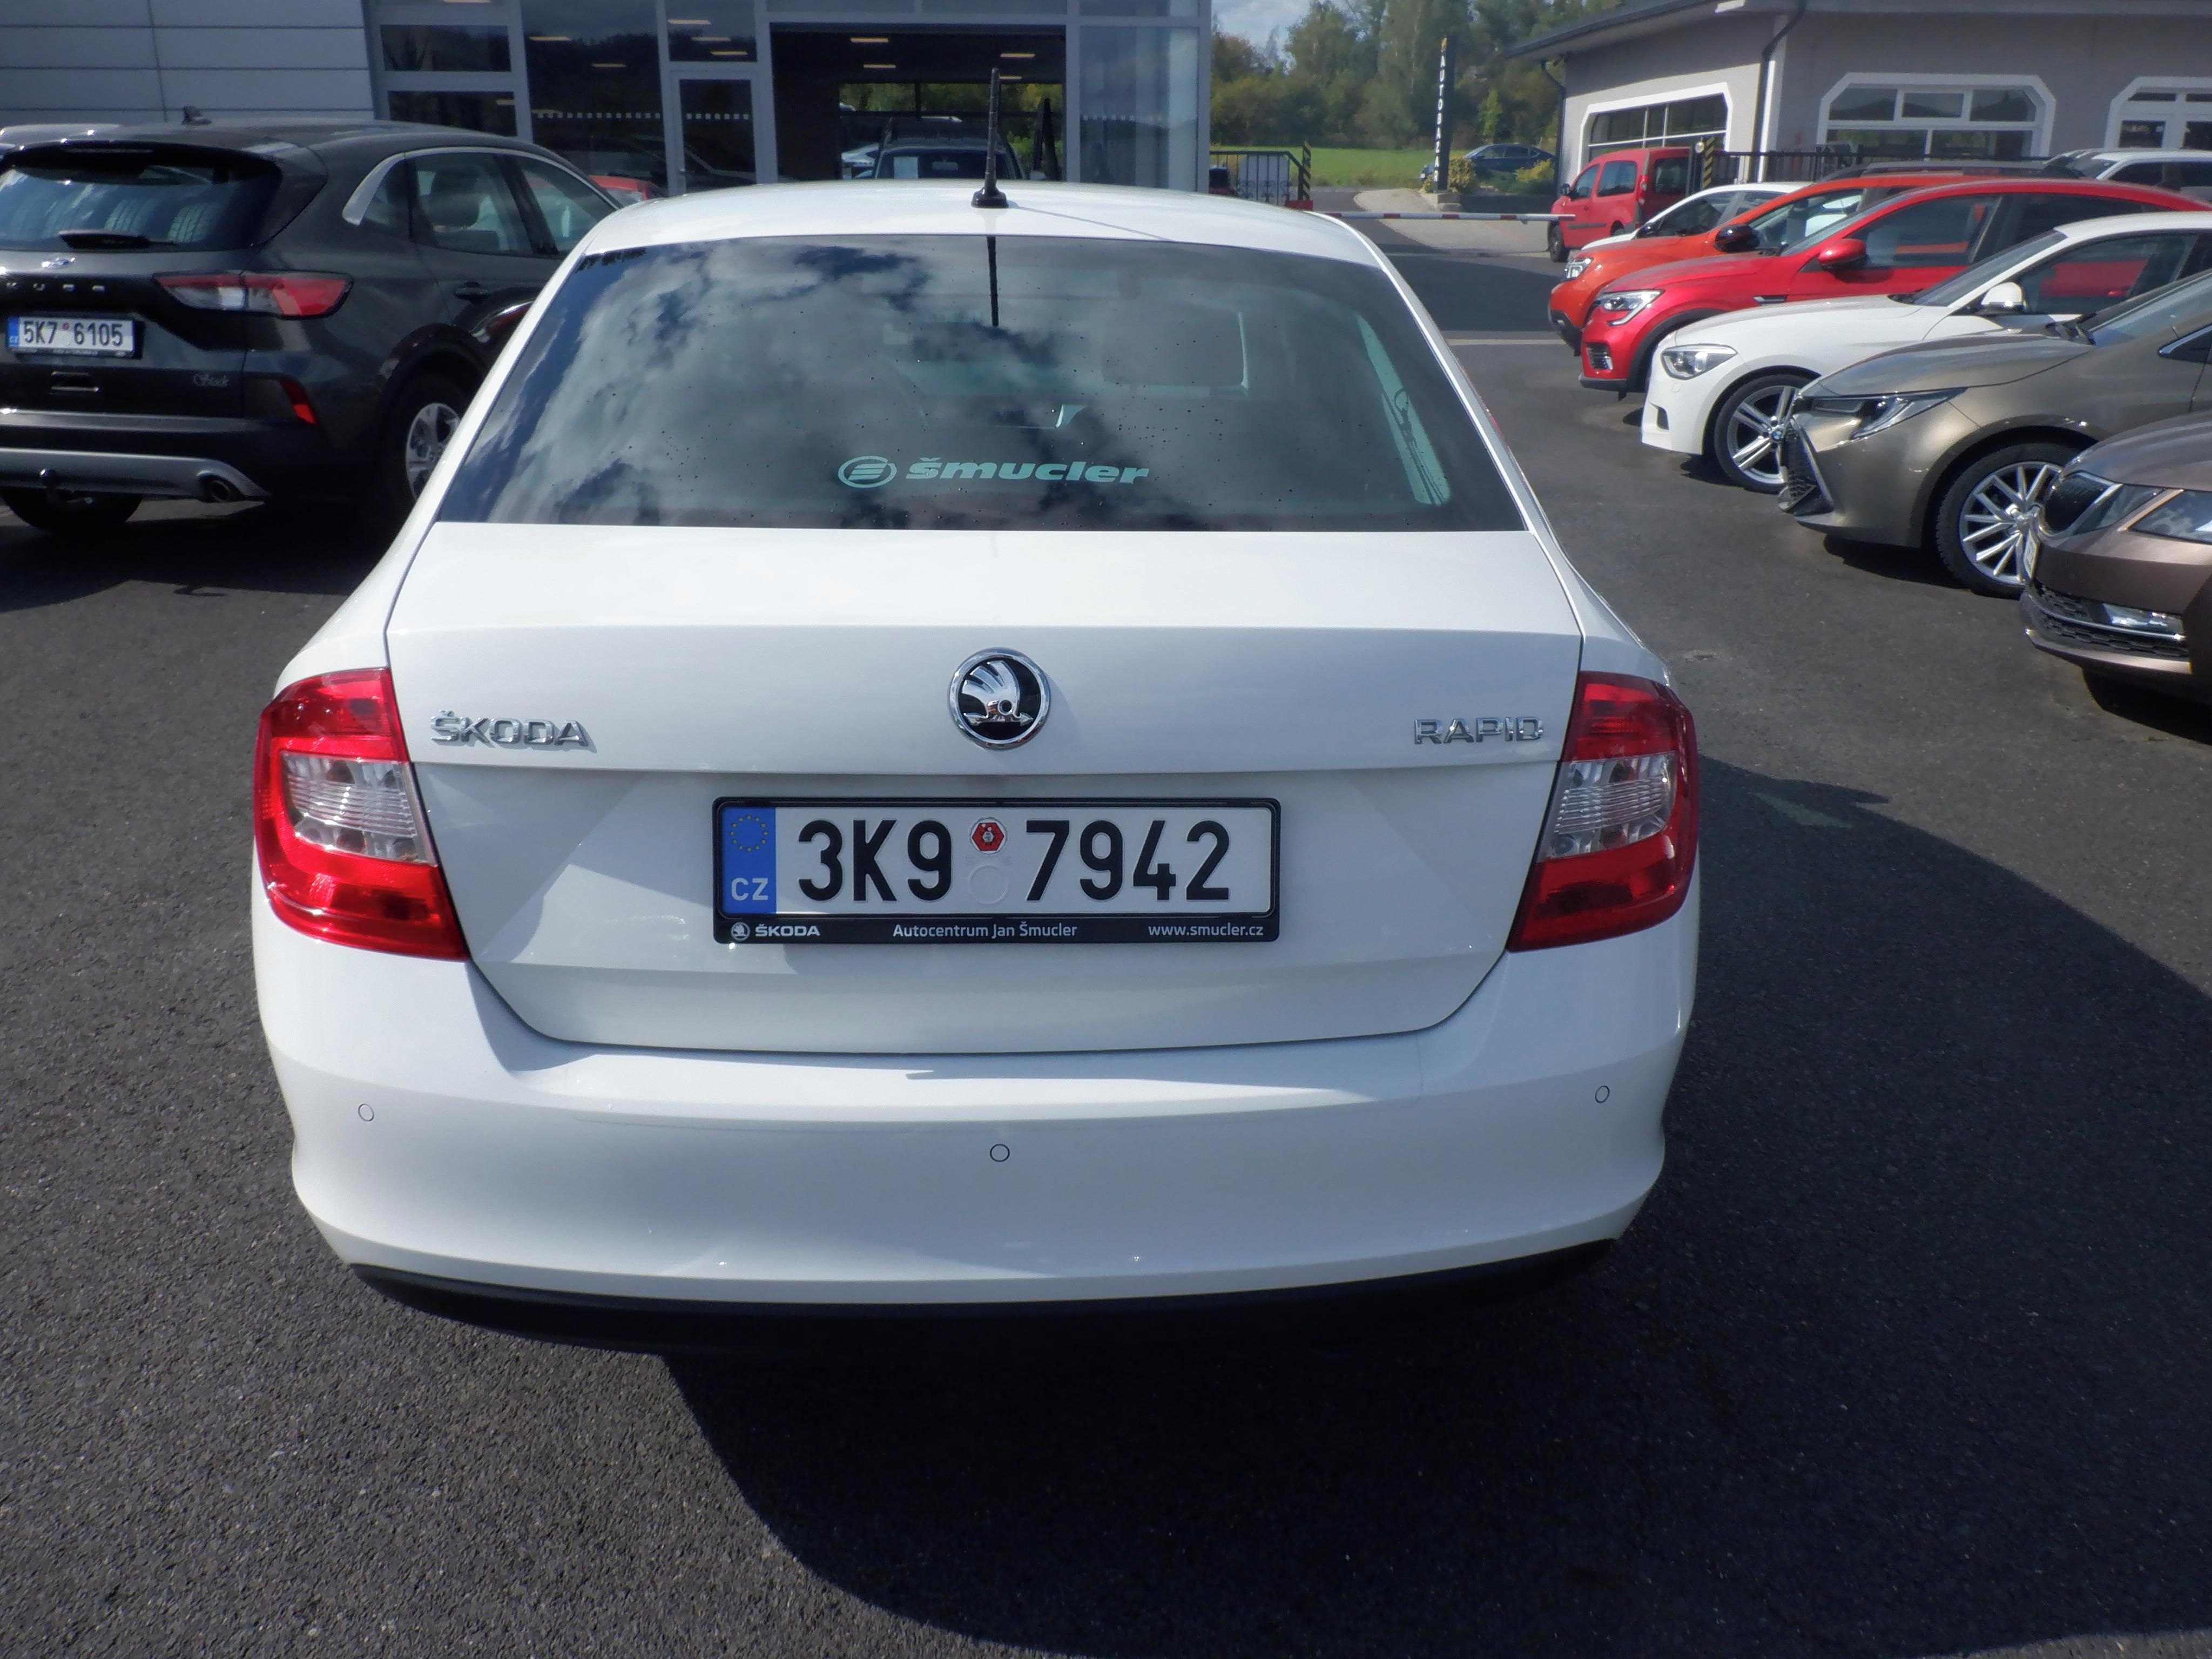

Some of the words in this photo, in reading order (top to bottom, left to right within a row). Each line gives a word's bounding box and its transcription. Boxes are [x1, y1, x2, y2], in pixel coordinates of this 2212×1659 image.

[1434, 55, 1446, 182] AUTOBAZAR
[24, 320, 57, 344] 5K7
[74, 322, 123, 346] 6105
[431, 709, 590, 747] ŠKODA
[1414, 716, 1543, 745] RAPID
[798, 819, 952, 901] 3K9
[1025, 820, 1230, 901] 7942
[731, 878, 768, 901] CZ
[755, 924, 820, 936] ŠKODA
[893, 924, 988, 937] Autocentrum
[992, 924, 1015, 939] Jan
[1019, 921, 1077, 936] Šmucler
[1148, 922, 1264, 936] www.smucler.cz
